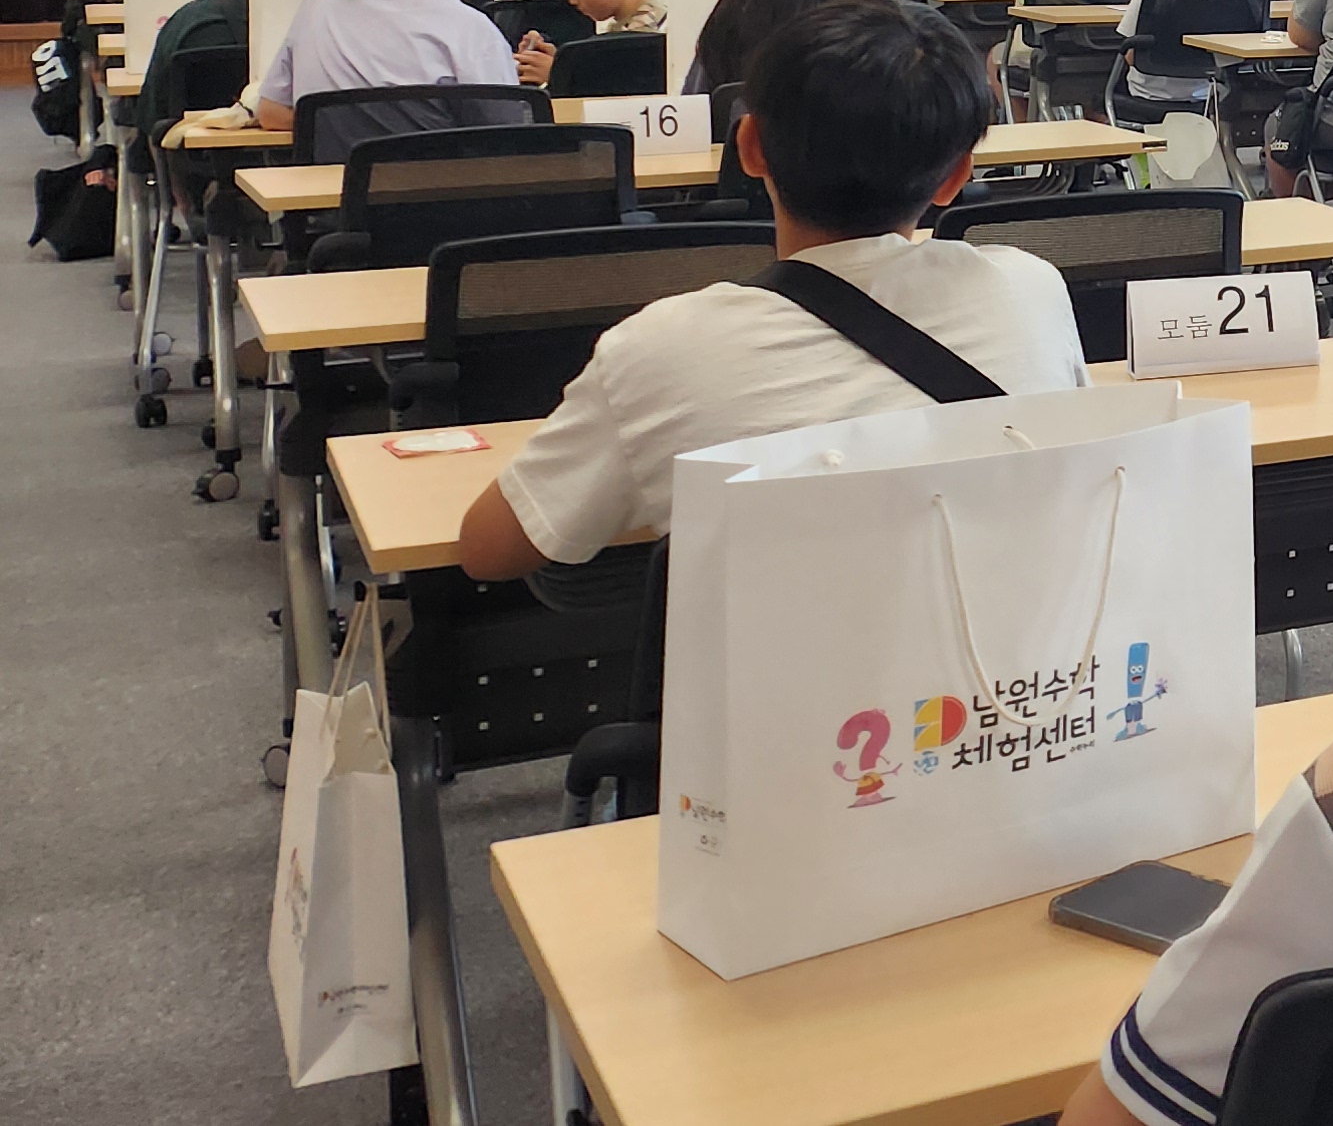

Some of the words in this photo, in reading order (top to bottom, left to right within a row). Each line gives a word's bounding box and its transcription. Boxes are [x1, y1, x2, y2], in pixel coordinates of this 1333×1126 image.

[640, 105, 678, 138] 16
[1157, 315, 1213, 340] 모둠
[1217, 284, 1275, 336] 21
[973, 655, 1101, 729] 남원수학
[951, 706, 1096, 773] 체험센터
